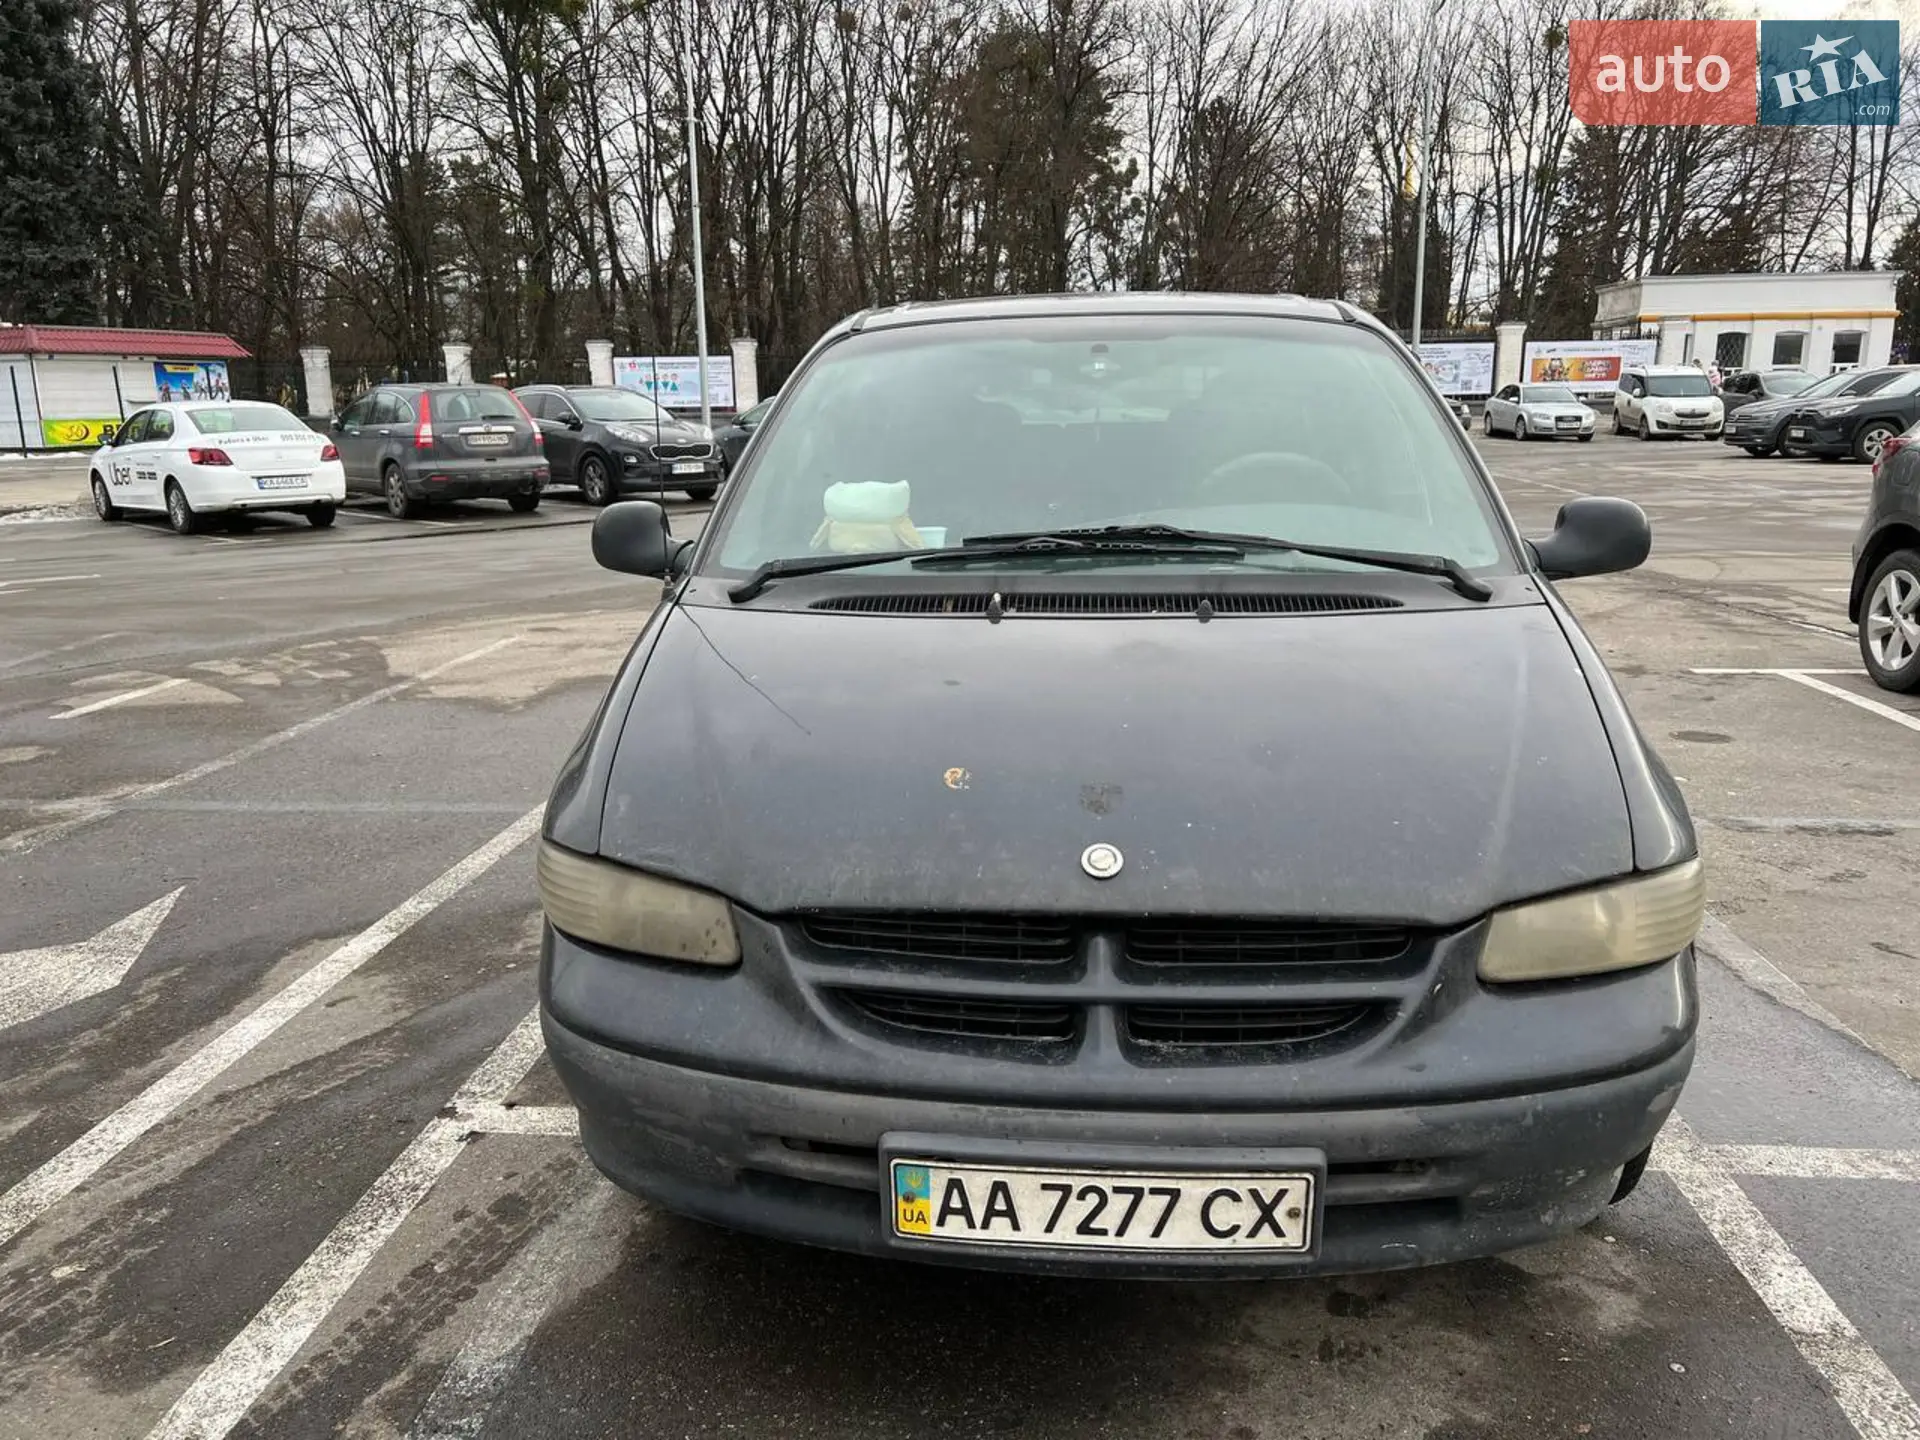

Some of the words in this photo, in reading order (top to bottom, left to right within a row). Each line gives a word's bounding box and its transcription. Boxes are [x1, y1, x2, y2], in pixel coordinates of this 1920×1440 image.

[108, 462, 132, 486] Uber
[902, 1207, 928, 1225] UA
[935, 1176, 1022, 1232] AA
[1040, 1182, 1182, 1239] 7277
[1200, 1186, 1290, 1240] CX
